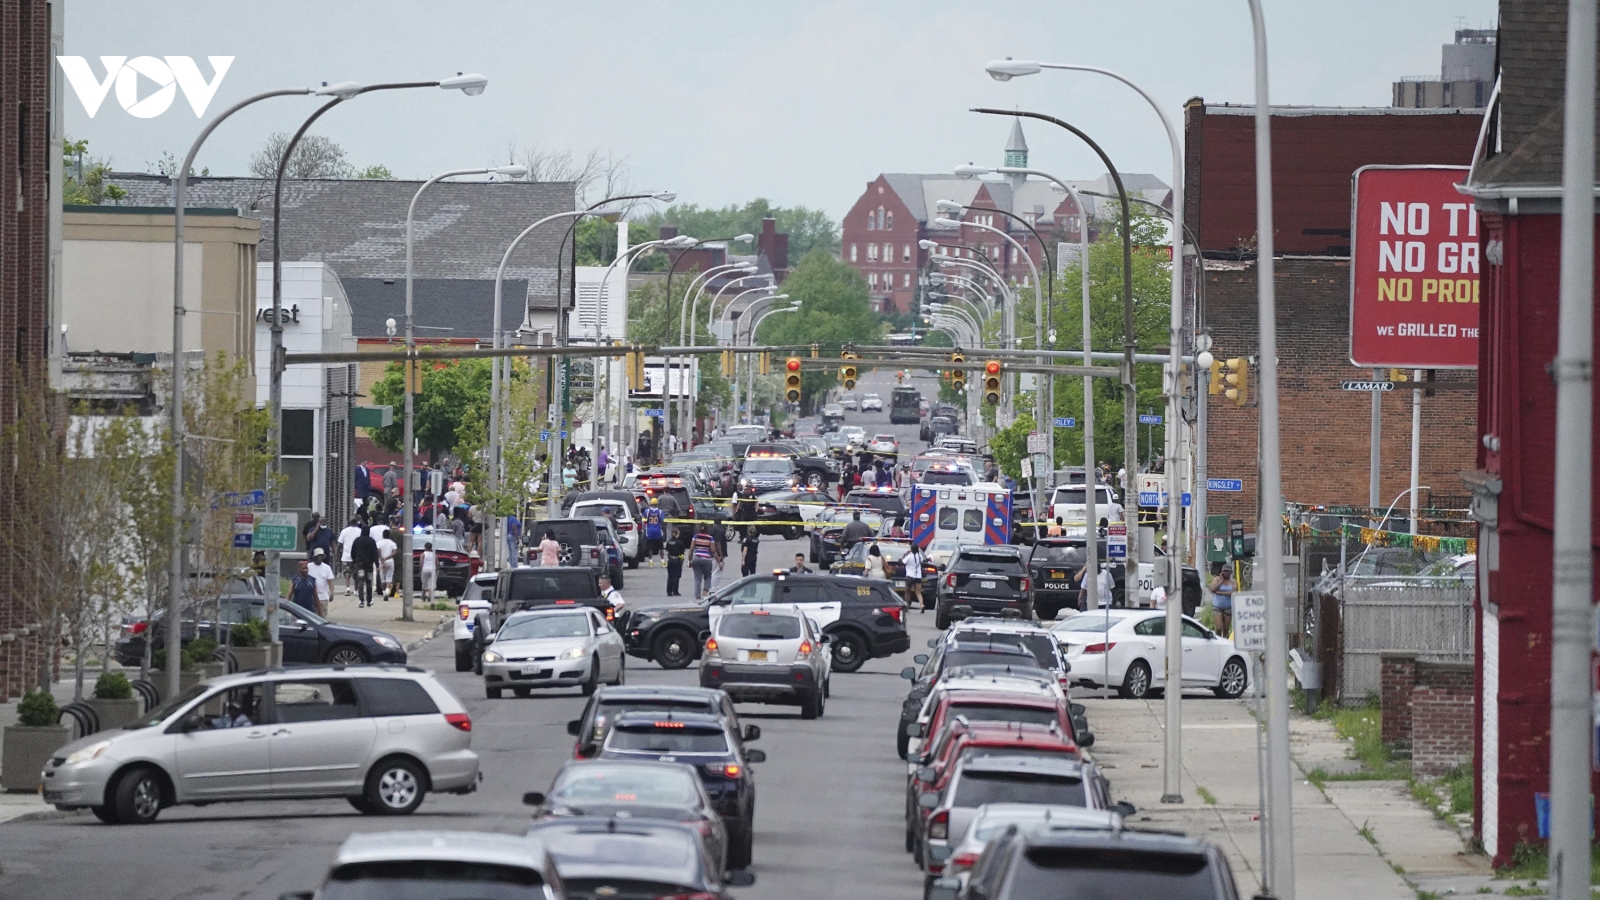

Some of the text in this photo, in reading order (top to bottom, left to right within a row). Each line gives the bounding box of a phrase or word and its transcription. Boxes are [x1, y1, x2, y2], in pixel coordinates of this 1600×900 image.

[1380, 202, 1478, 237] NO TI
[1378, 241, 1480, 274] NO GR
[1377, 278, 1413, 302] NO
[1376, 325, 1395, 336] WE
[1397, 323, 1457, 338] GRILLED
[1348, 382, 1389, 391] LAMAR
[1208, 481, 1235, 490] KINGSLEY
[1245, 597, 1265, 607] END
[1237, 611, 1266, 620] SCHO
[1241, 624, 1265, 634] SPEE
[1243, 638, 1266, 647] LIMI
